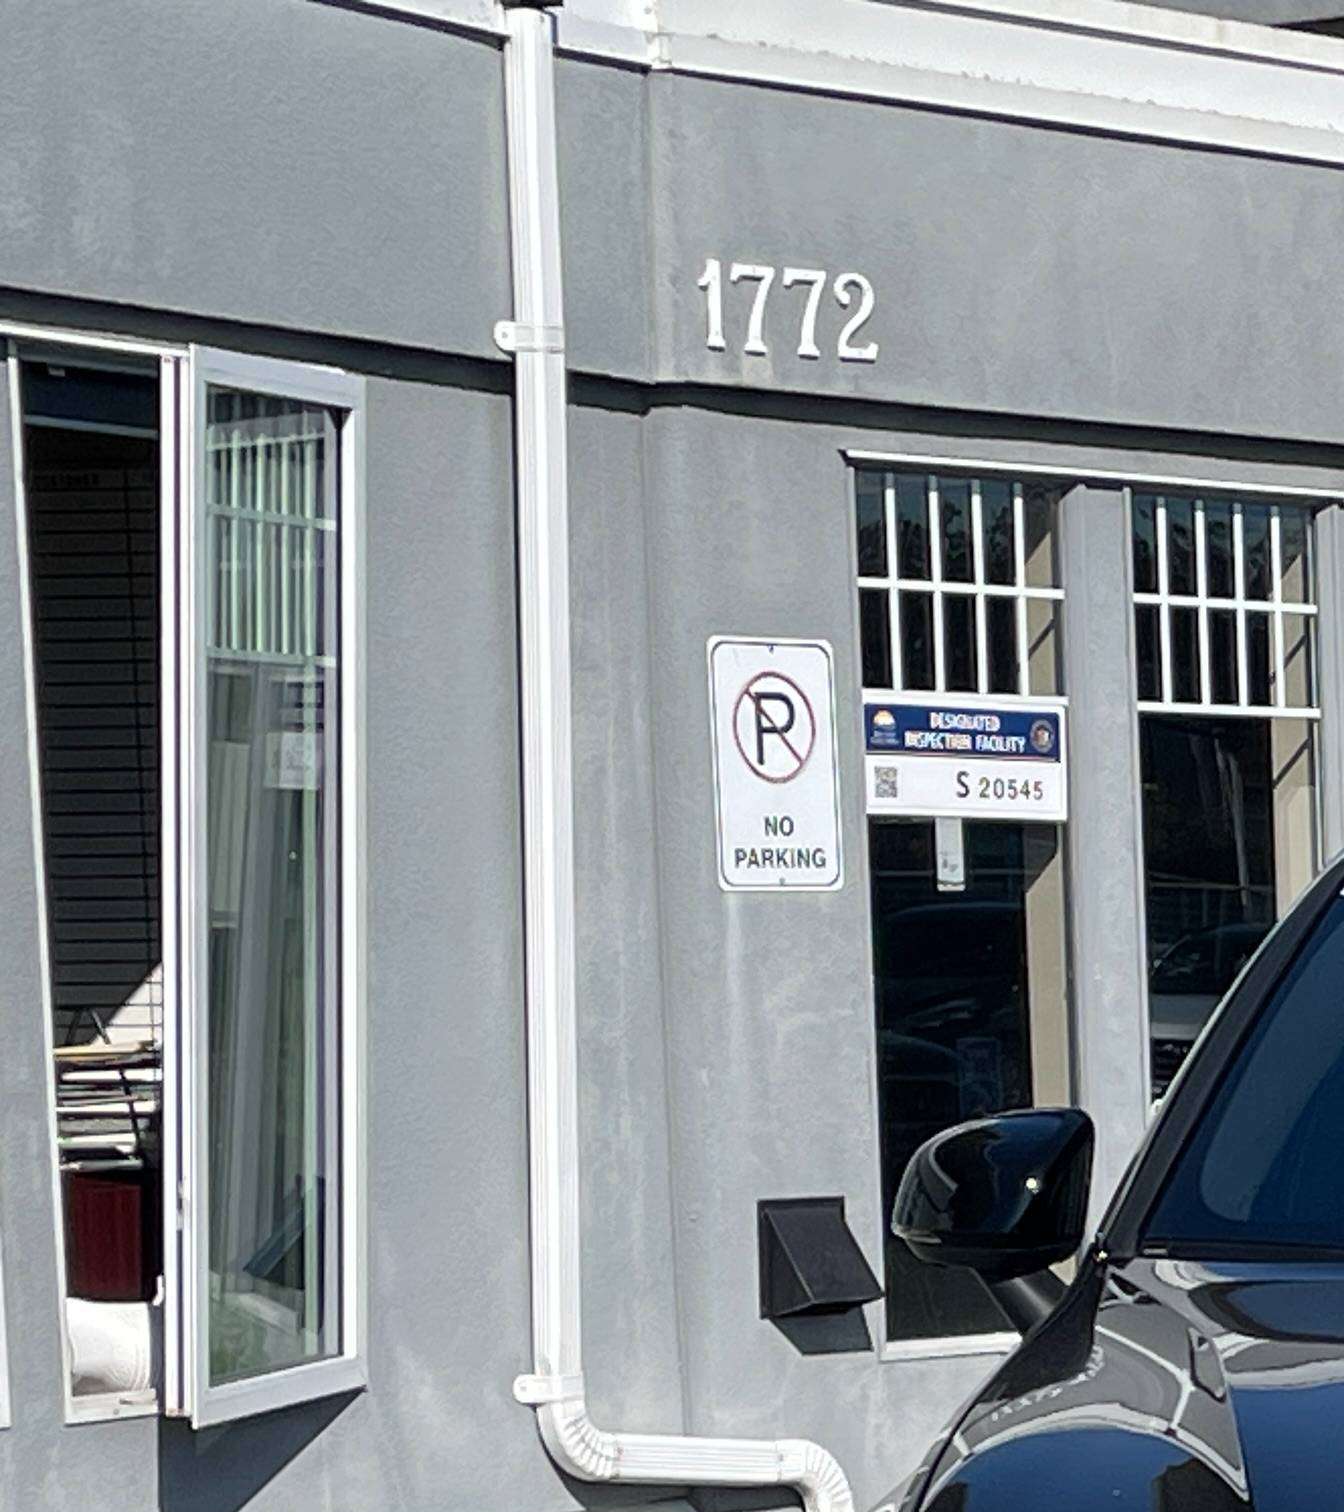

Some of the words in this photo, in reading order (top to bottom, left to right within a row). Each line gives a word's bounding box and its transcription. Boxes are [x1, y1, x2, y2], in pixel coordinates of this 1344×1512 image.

[698, 258, 879, 361] 1772
[956, 771, 970, 798] S
[978, 777, 1044, 801] 20545
[764, 816, 795, 837] NO
[734, 848, 827, 869] PARKING
